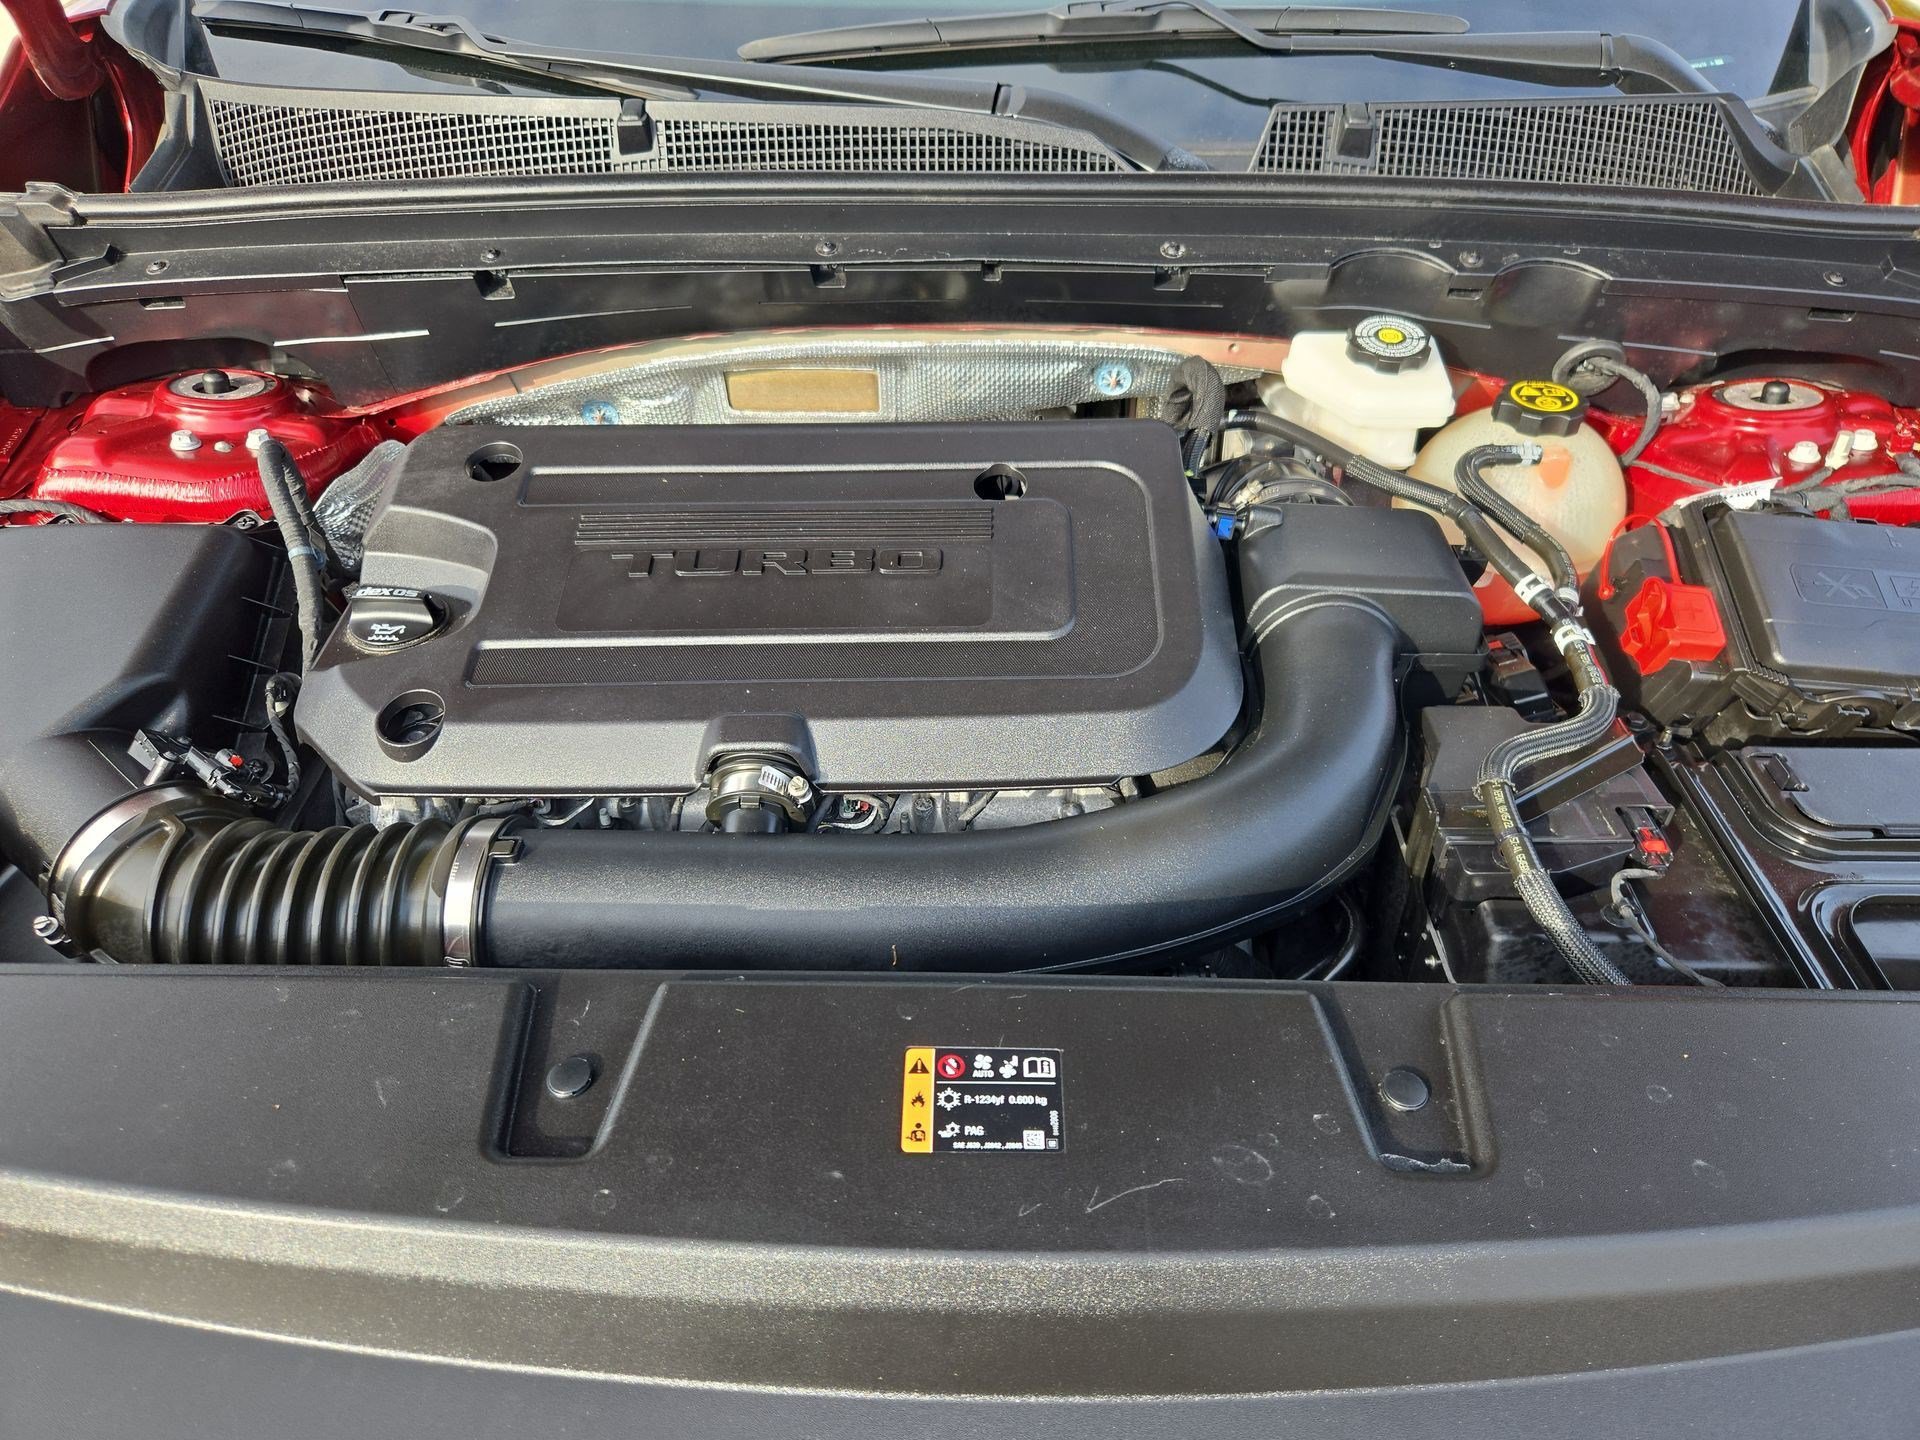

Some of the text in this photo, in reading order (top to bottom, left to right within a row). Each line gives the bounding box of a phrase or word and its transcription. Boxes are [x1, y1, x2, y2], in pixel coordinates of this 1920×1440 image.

[611, 548, 943, 578] TURBO
[972, 1069, 995, 1078] AUTO
[964, 1094, 1048, 1107] R-1234yf 0.600 kg
[964, 1125, 985, 1136] PAG
